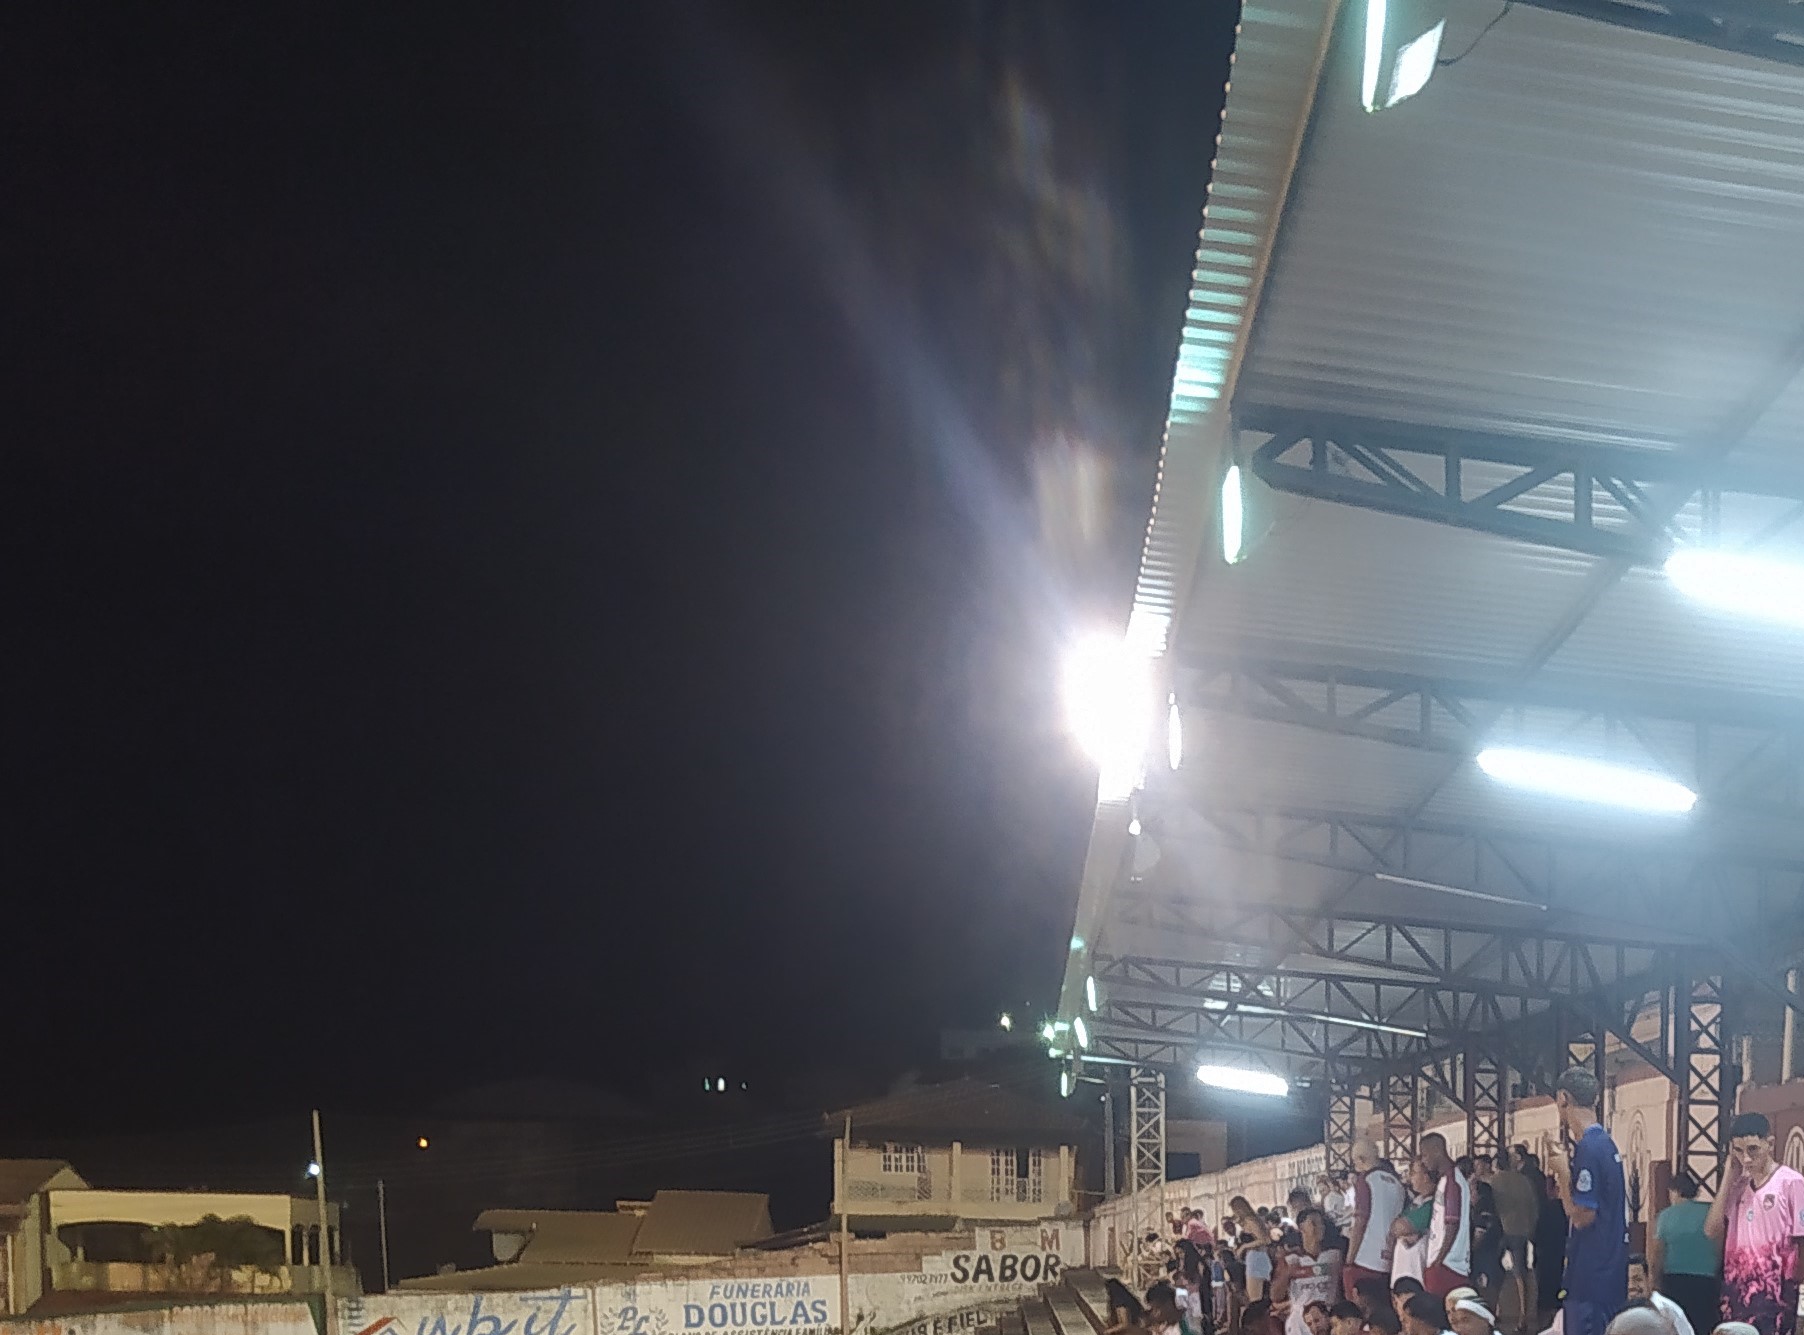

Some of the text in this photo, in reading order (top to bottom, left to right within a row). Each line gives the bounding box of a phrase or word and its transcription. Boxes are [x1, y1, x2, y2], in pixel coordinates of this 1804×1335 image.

[950, 1254, 1061, 1283] SABOR
[709, 1280, 811, 1299] FUNERÁRIA
[684, 1299, 828, 1329] DOUGLAS
[948, 1310, 987, 1334] FIEL
